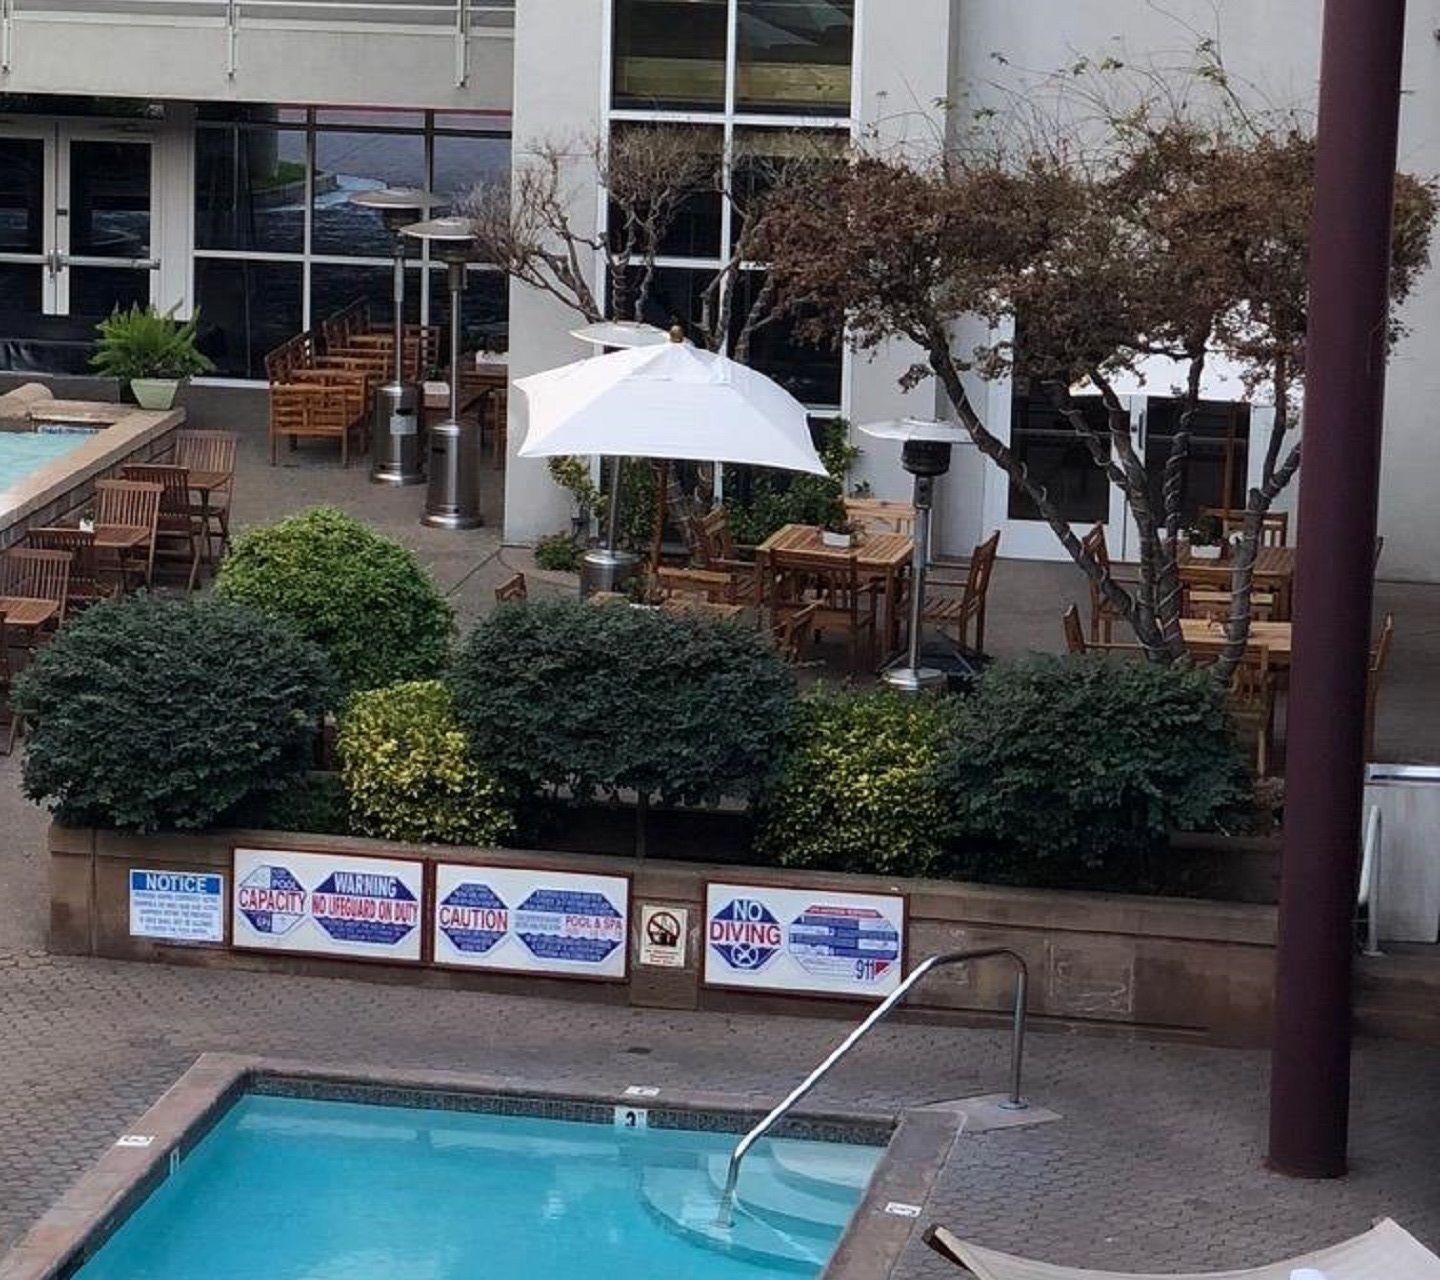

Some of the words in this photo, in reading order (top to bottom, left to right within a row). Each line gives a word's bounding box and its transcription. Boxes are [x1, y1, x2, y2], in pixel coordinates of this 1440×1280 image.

[146, 873, 207, 892] NOTICE
[334, 872, 397, 898] WARNING
[239, 888, 306, 913] CAPACITY
[311, 894, 327, 915] NO
[329, 896, 376, 919] LIFEGUARD
[378, 900, 392, 921] ON
[394, 902, 418, 924] DUTY
[733, 899, 763, 920] NO
[440, 907, 508, 930] CAUTION
[710, 921, 781, 946] DIVING
[855, 959, 875, 980] 911
